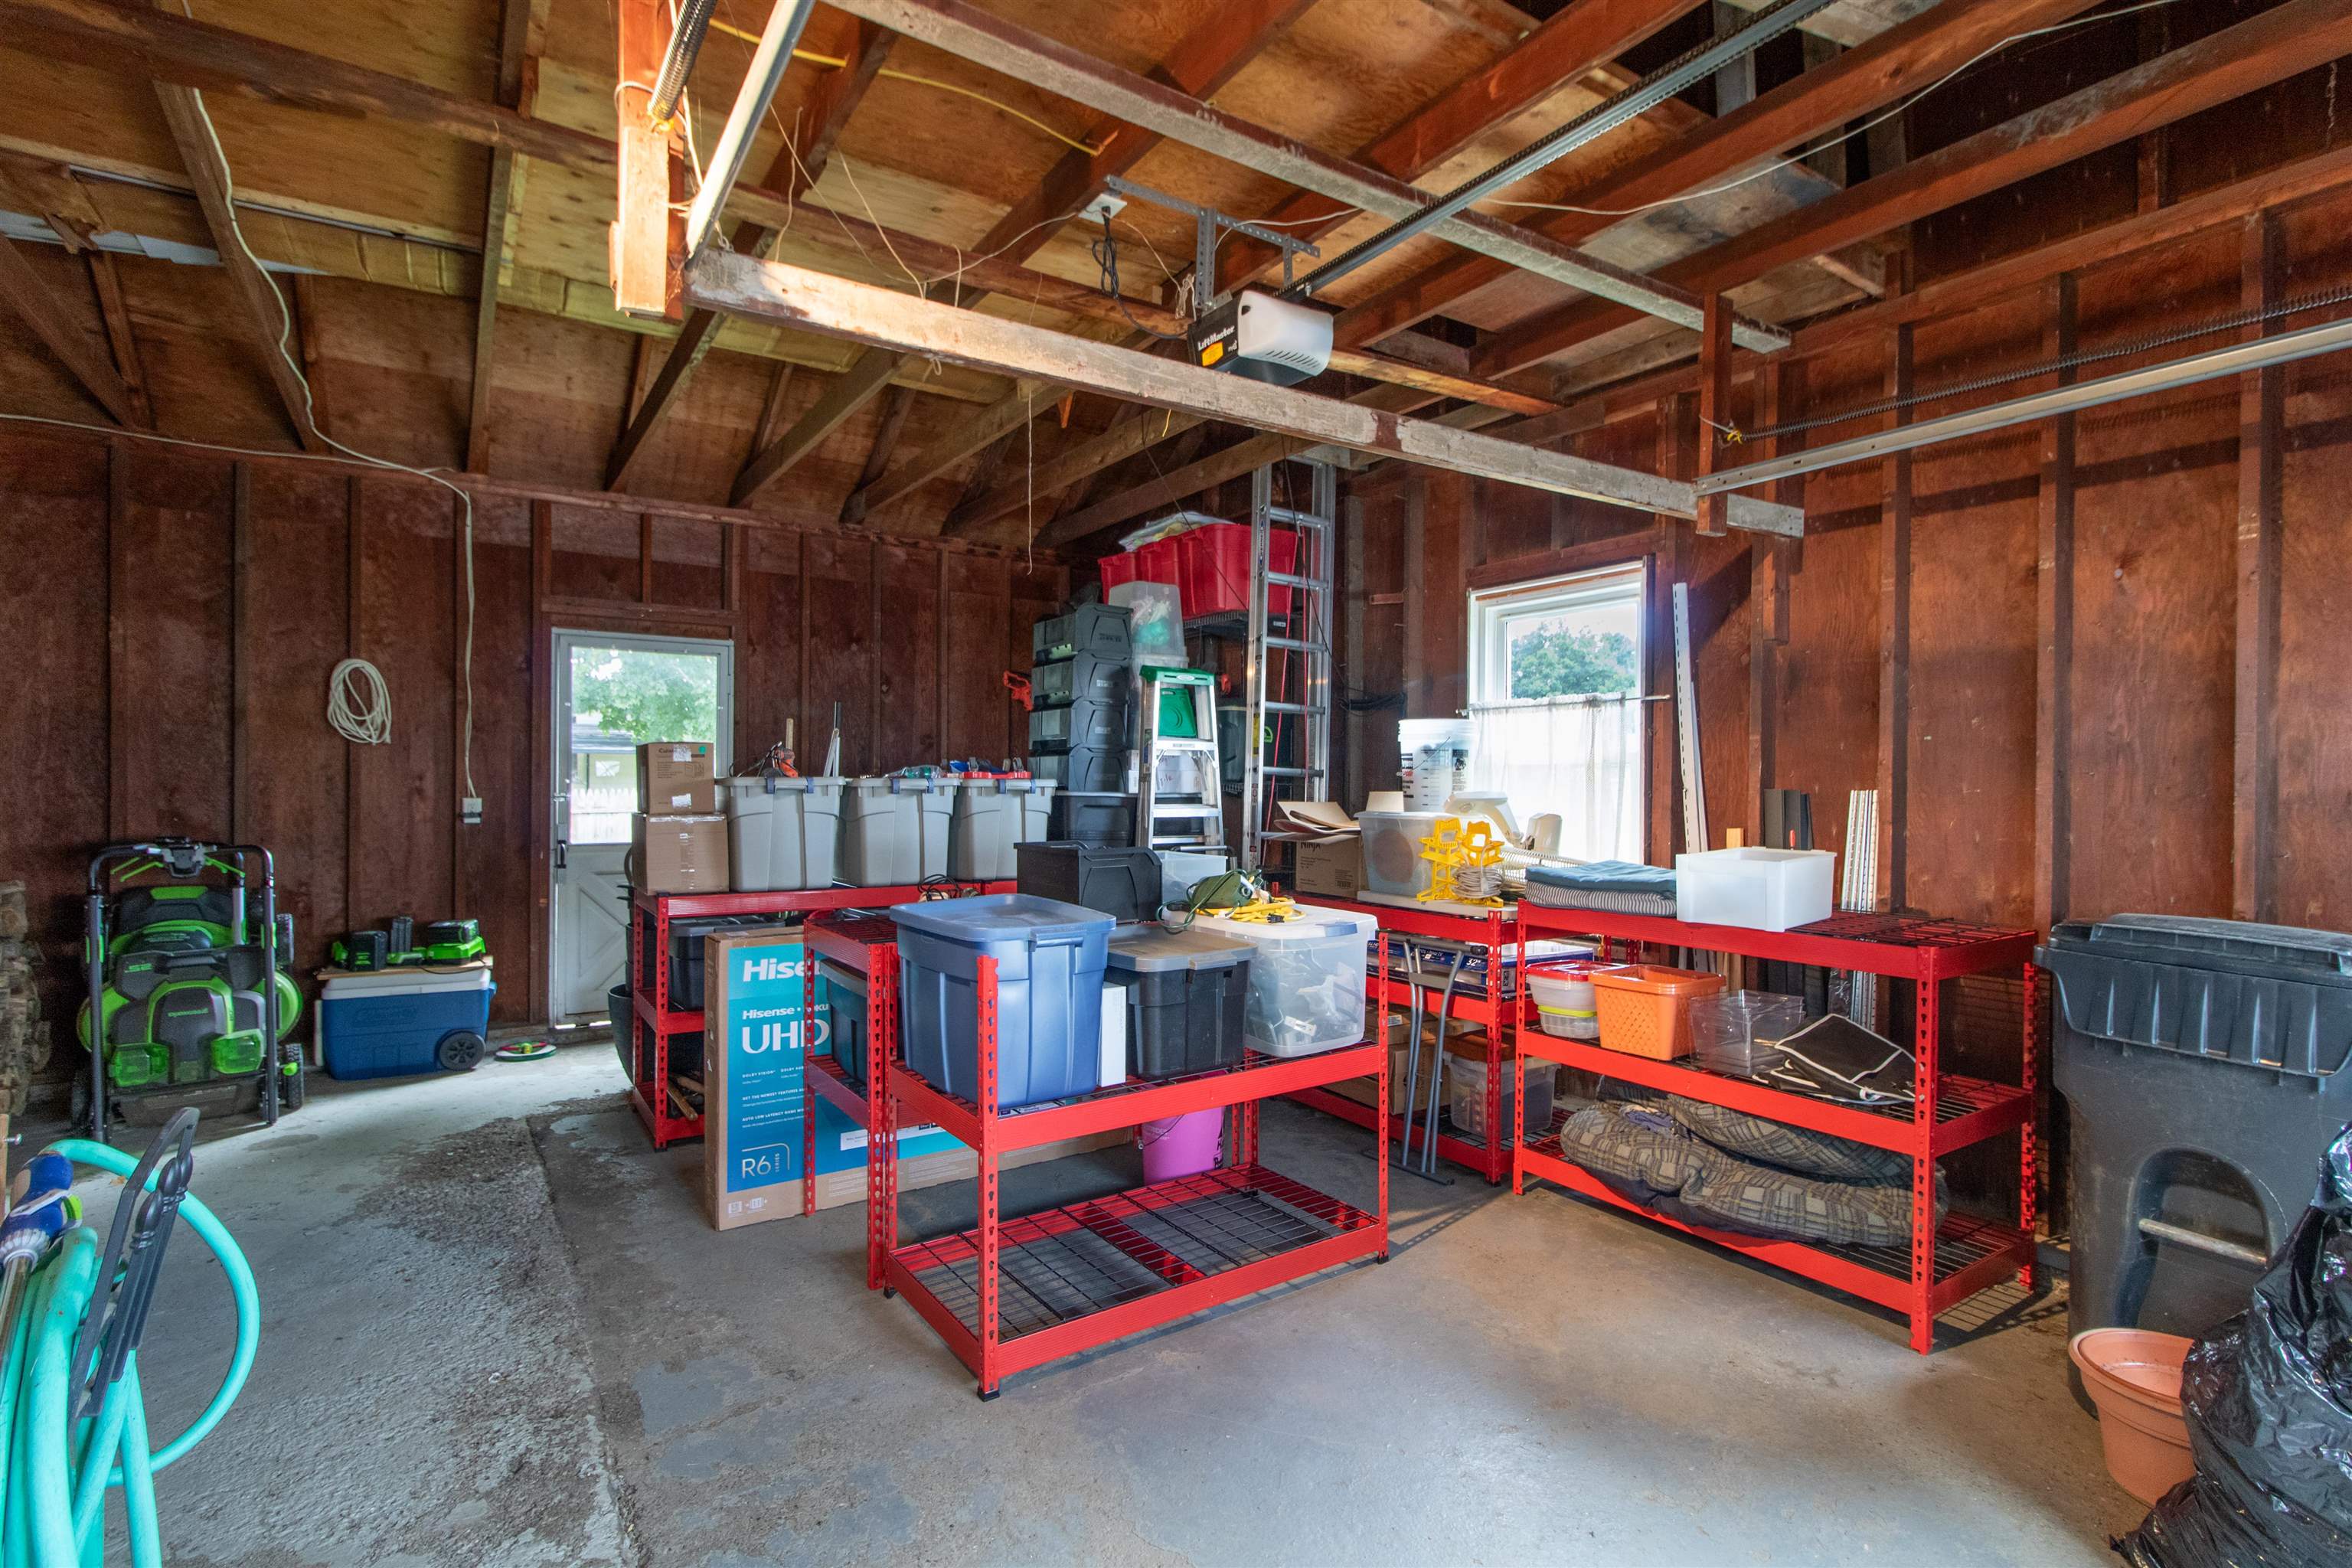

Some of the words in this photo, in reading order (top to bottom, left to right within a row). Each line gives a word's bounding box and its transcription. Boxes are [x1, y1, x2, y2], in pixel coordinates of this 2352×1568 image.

[1197, 326, 1235, 351] LiftMaster
[1300, 841, 1321, 852] NINJA
[1466, 958, 1481, 966] 32"
[742, 1008, 795, 1020] Hisense
[742, 1019, 830, 1054] UHD
[741, 1155, 772, 1179] R6
